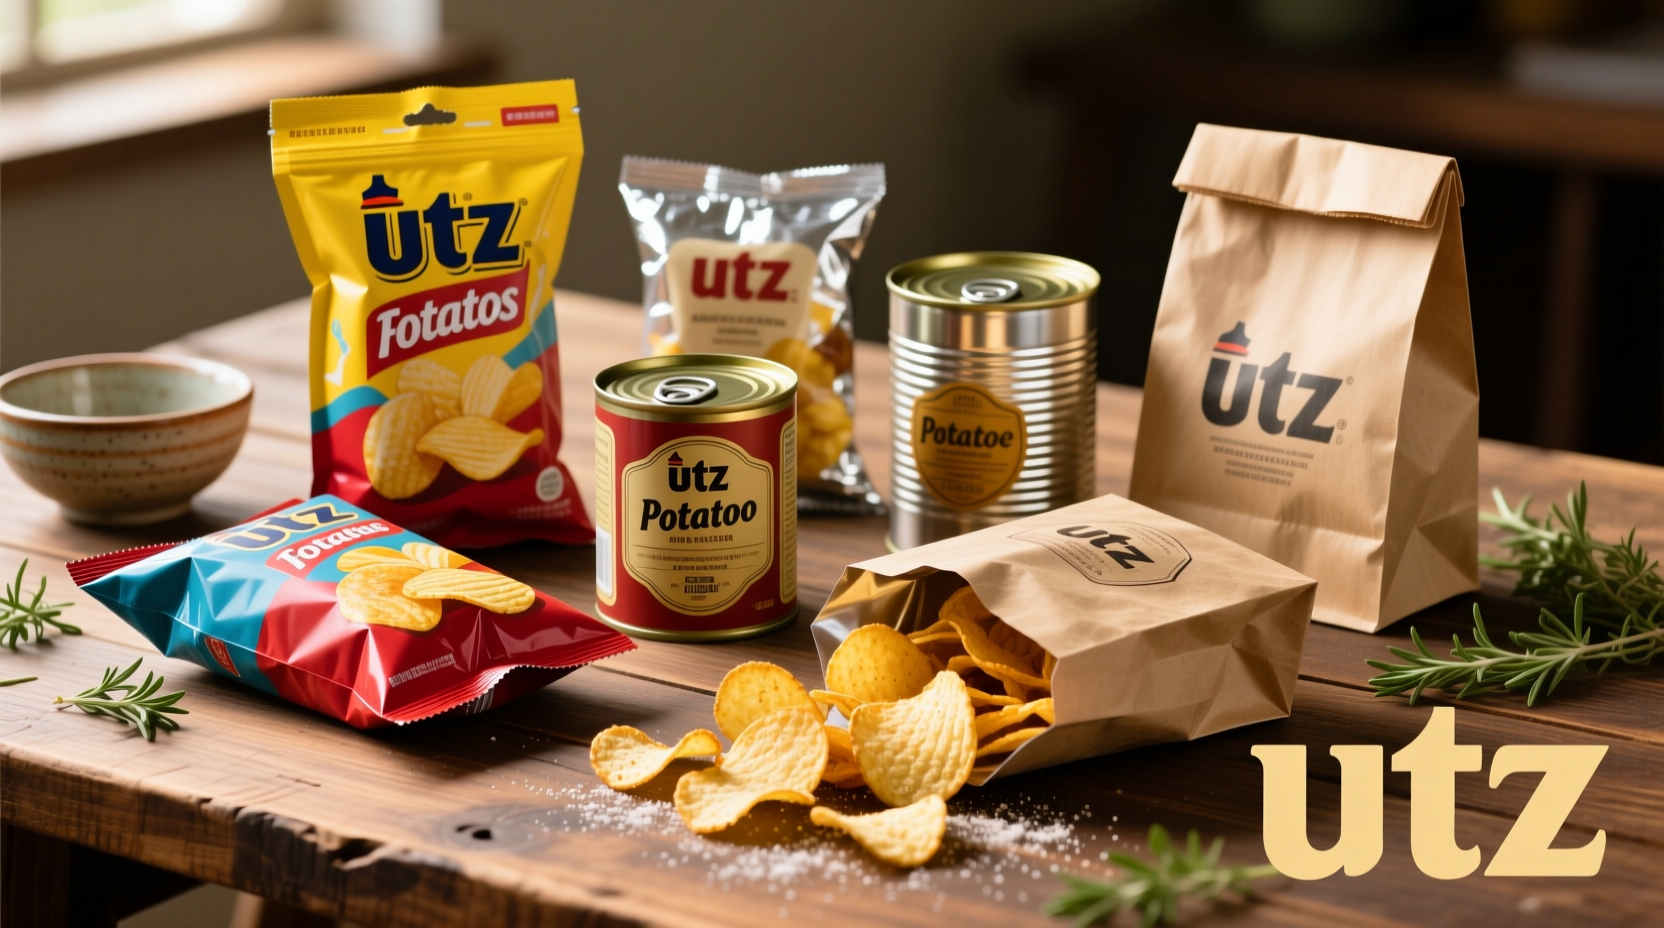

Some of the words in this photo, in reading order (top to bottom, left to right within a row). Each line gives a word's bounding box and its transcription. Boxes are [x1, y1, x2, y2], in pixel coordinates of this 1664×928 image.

[691, 252, 792, 301] utz
[376, 286, 519, 359] Fotatos
[920, 416, 1014, 449] Potatoe
[640, 499, 757, 532] Potatoo
